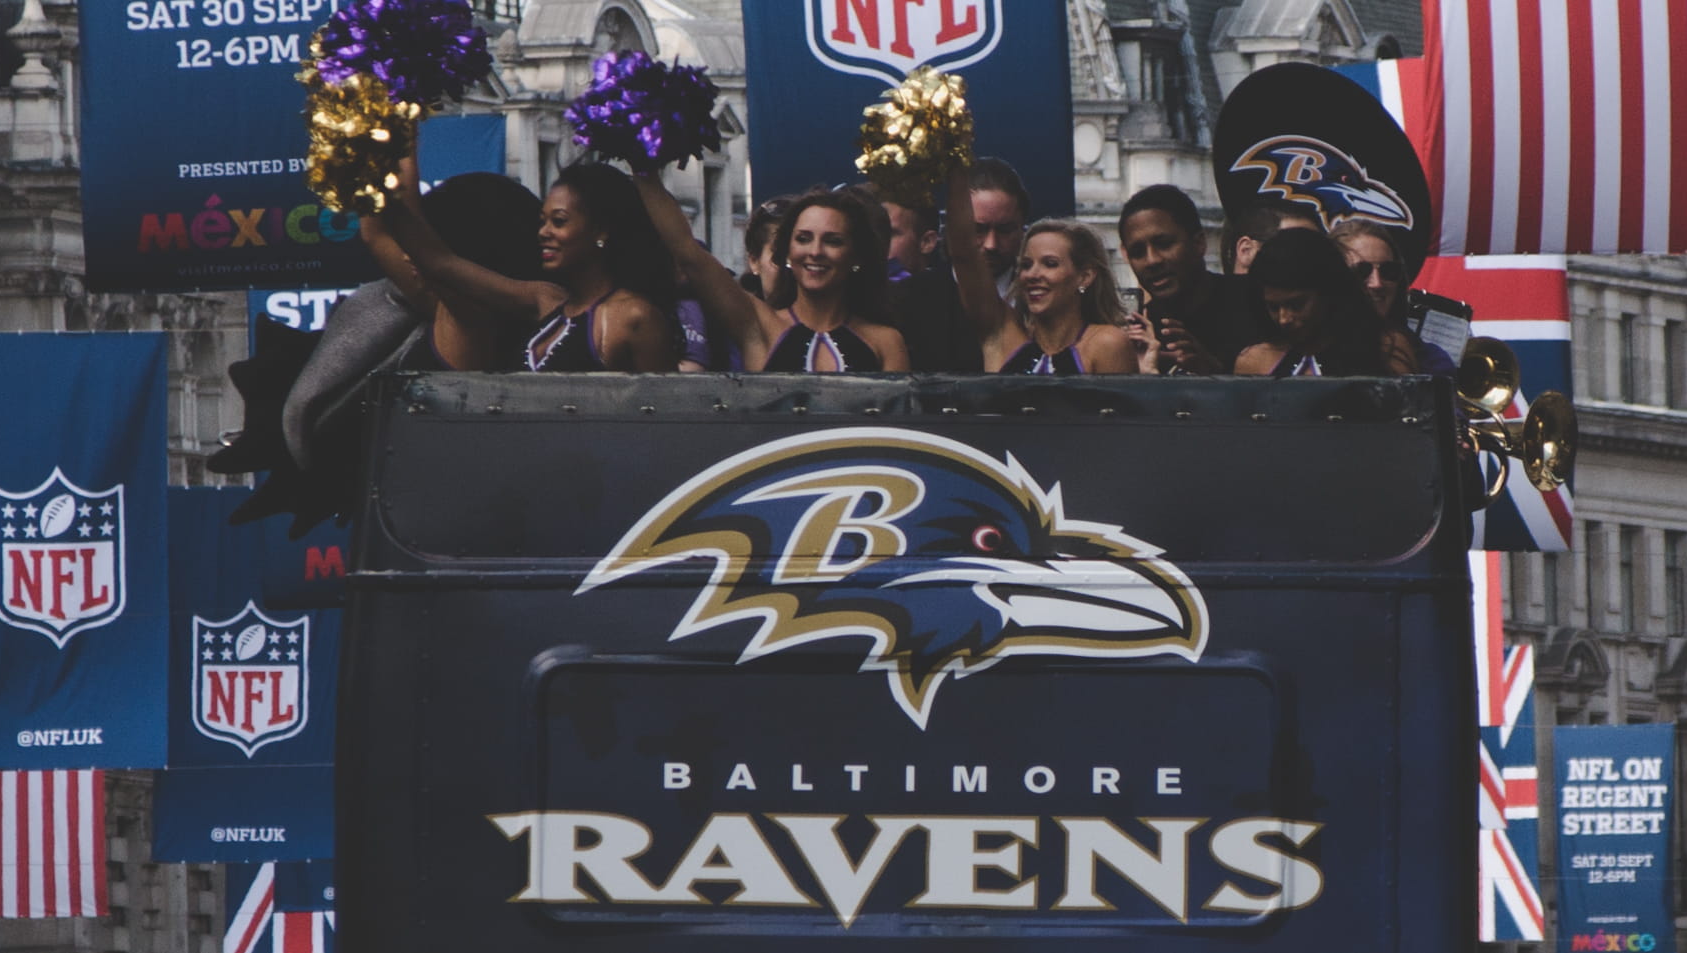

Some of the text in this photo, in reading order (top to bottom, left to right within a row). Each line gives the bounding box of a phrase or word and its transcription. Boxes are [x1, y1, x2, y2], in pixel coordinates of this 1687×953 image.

[126, 0, 195, 31] SAT
[175, 33, 301, 69] 12-6PM
[178, 158, 284, 179] PRESENTED
[8, 548, 109, 621] NFL
[206, 669, 294, 734] NFL
[16, 727, 103, 748] @NFLUK
[662, 762, 1183, 796] BALTIMORE
[1567, 757, 1663, 782] NFL ON
[1561, 785, 1668, 809] REGENT
[210, 826, 286, 843] @NFLUK
[1562, 811, 1666, 836] STREET
[484, 809, 1327, 930] RAVENS
[1571, 854, 1655, 869] SAT 30 SEPT
[1587, 870, 1637, 884] 12-6PM
